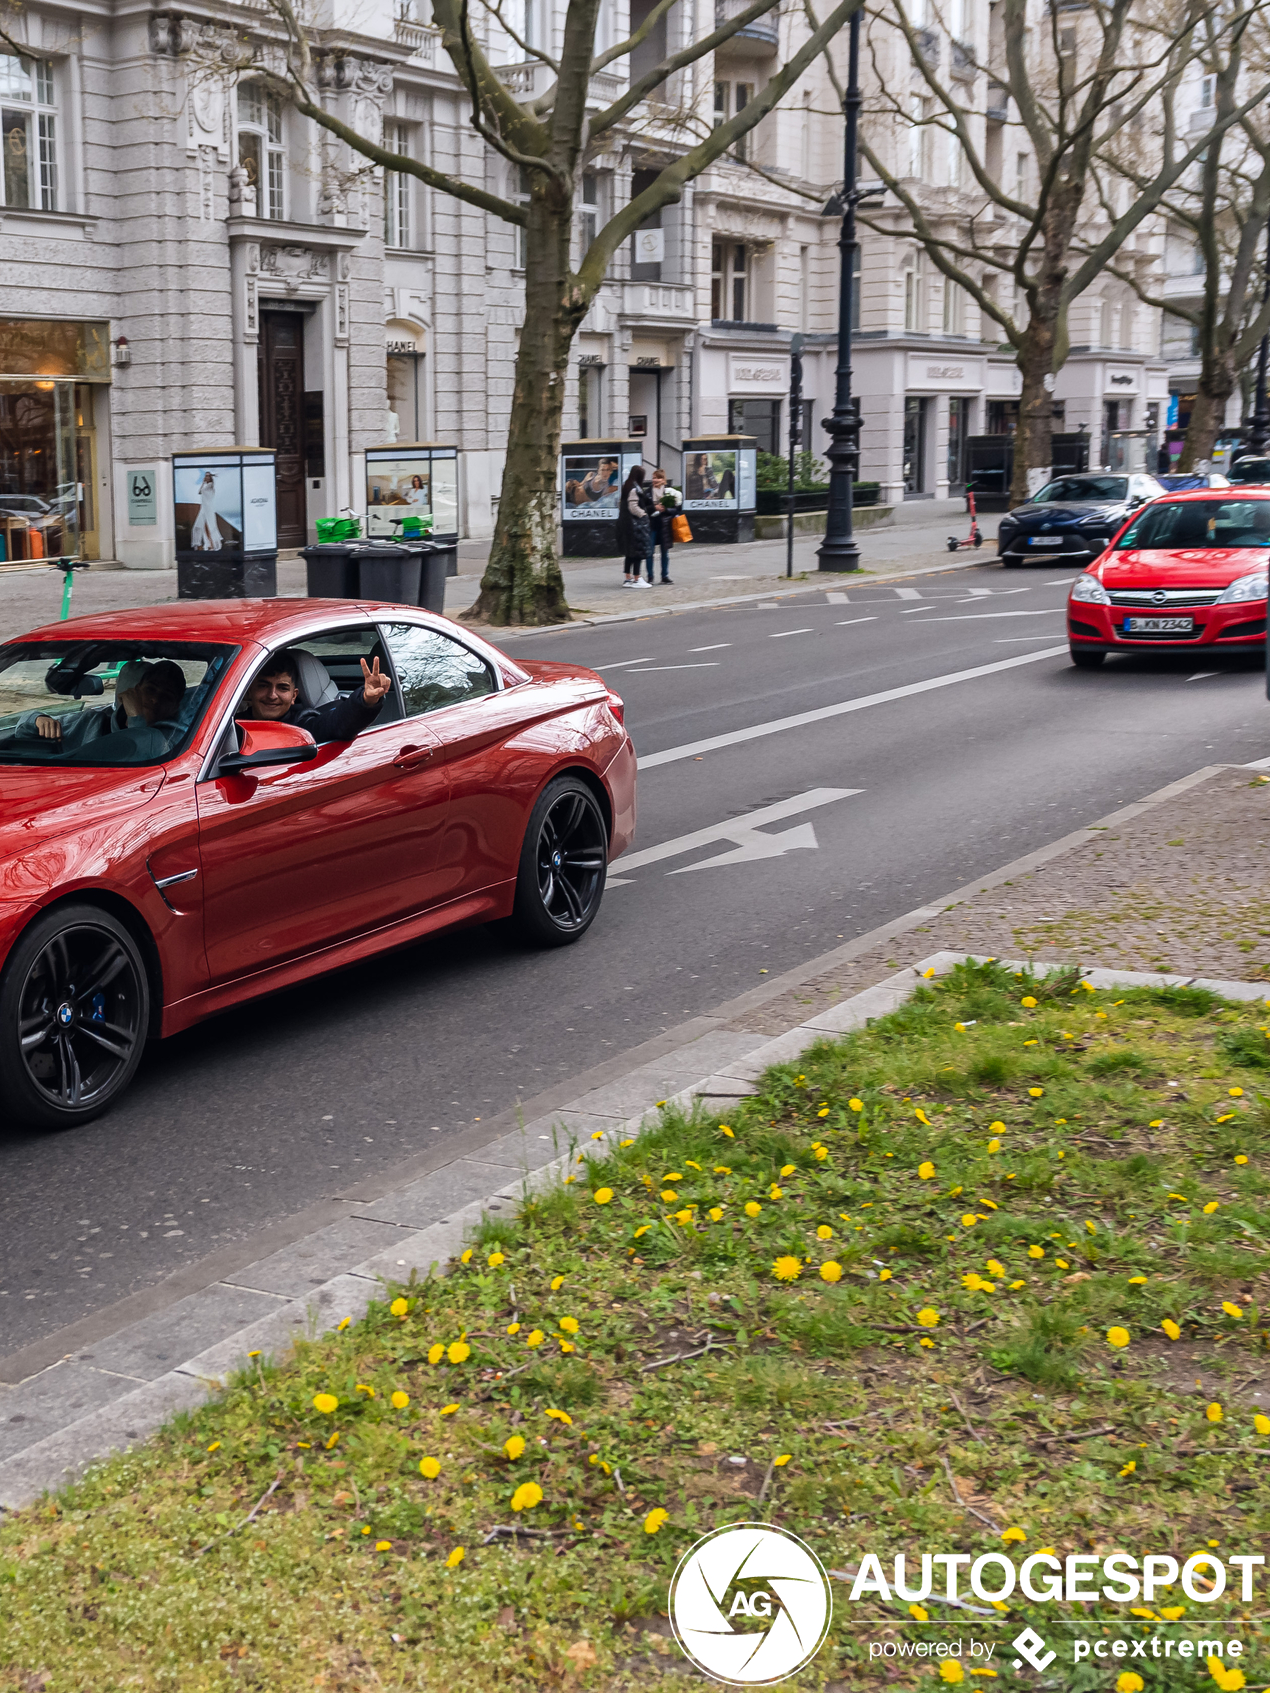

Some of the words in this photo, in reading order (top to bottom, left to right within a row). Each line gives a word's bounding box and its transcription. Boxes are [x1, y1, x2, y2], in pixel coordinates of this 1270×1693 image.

[386, 340, 417, 352] HANEL
[690, 500, 730, 509] CHANEL
[570, 510, 613, 518] CHANEL
